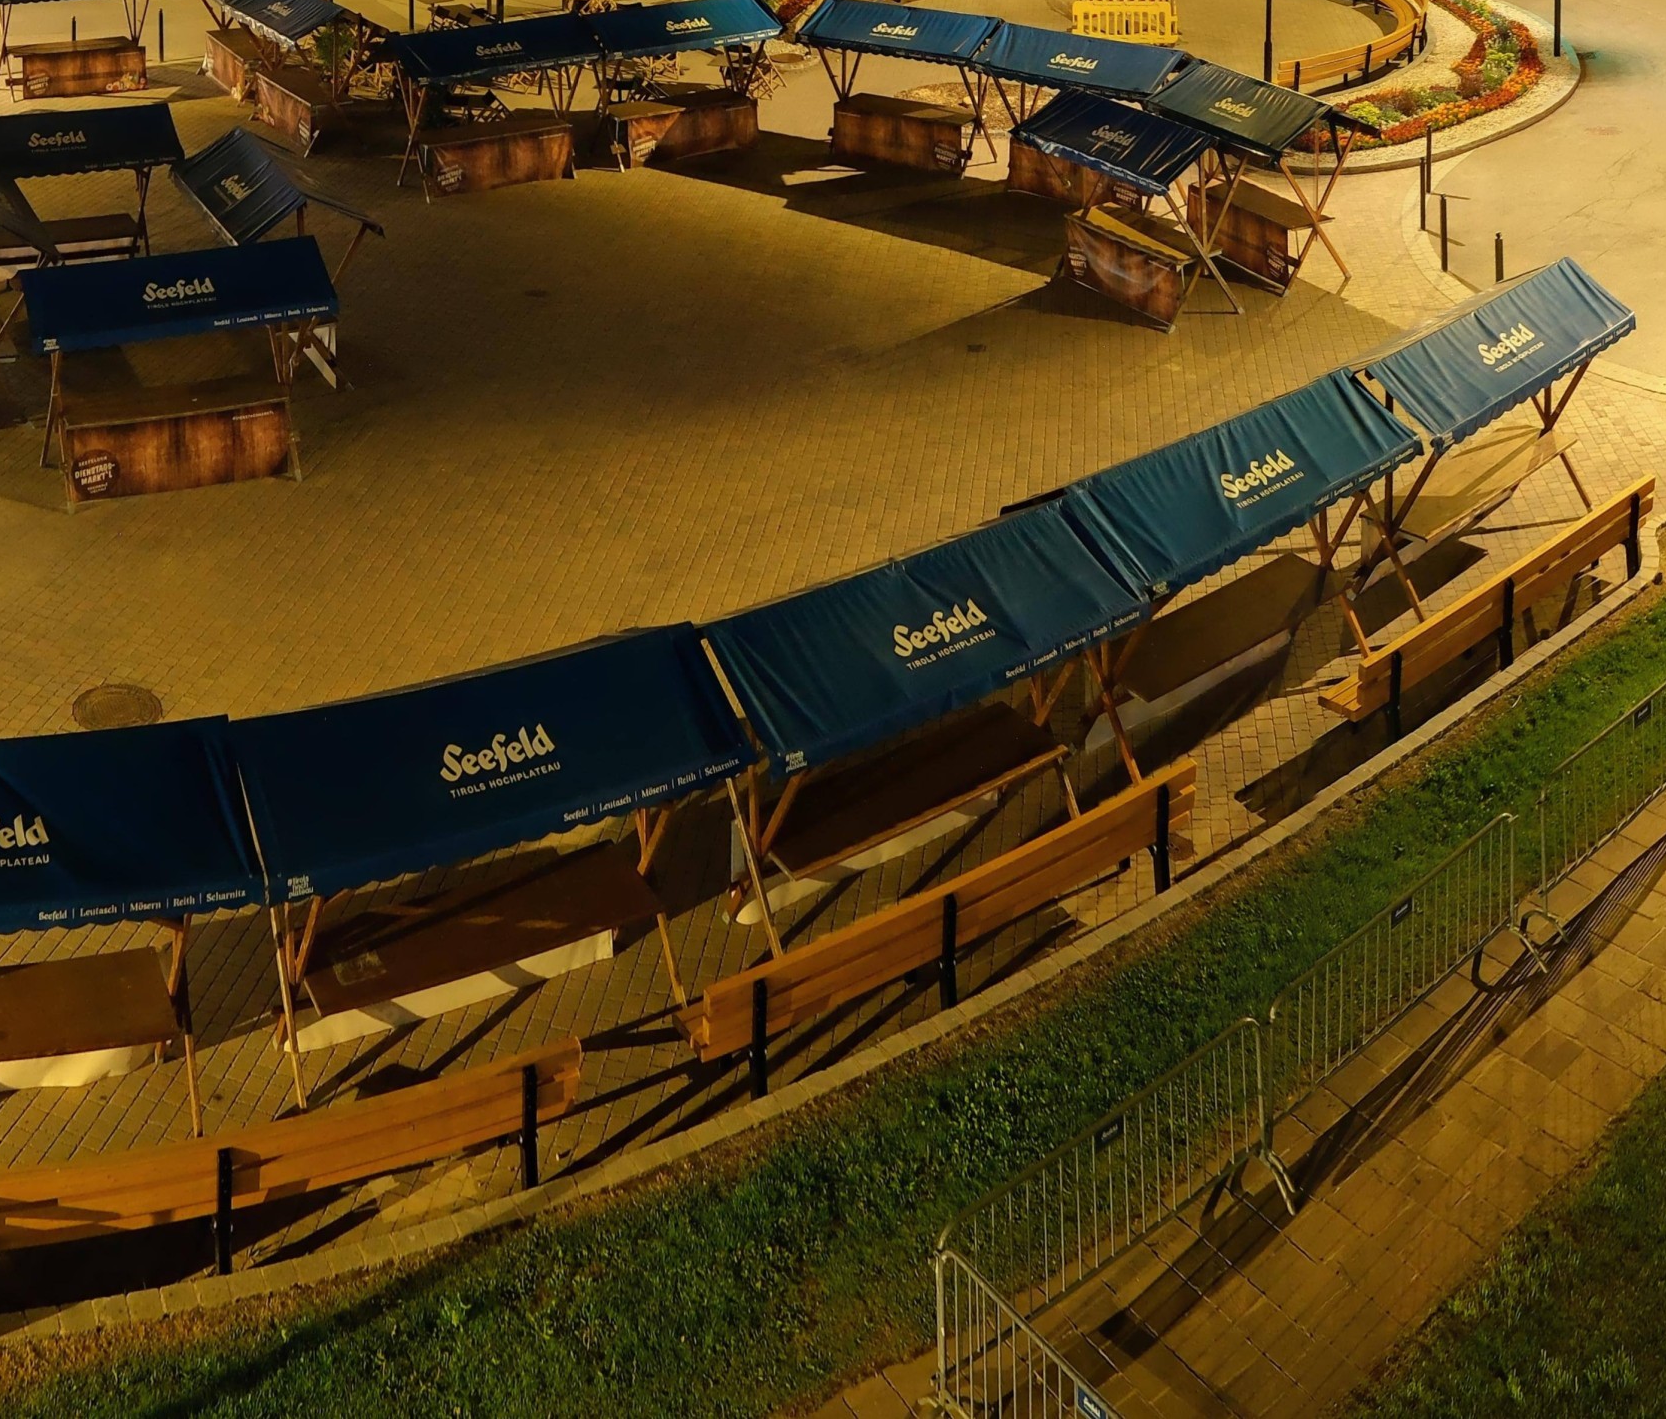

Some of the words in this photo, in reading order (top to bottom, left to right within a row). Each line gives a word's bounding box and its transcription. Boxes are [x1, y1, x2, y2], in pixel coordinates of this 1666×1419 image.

[666, 17, 711, 32] Seefeld
[872, 23, 919, 36] Seefeld
[476, 41, 522, 57] Seefeld
[1050, 53, 1098, 70] Seefeld
[1214, 97, 1259, 119] Seefeld
[28, 130, 87, 149] Seefeld
[1091, 125, 1137, 147] Seefeld
[143, 277, 215, 303] Seefeld
[1477, 322, 1536, 366] Seefeld
[1220, 448, 1295, 499] Seefeld
[1236, 493, 1260, 510] TIROLS
[1259, 470, 1305, 498] HOCHPLATEAU
[893, 598, 988, 658] Seefeld
[906, 652, 937, 671] TIROLS
[937, 628, 996, 660] HOCHPLATEAU
[1005, 665, 1026, 679] Seefeld
[1033, 649, 1058, 666] Leutasch
[439, 723, 556, 783] Seefeld
[450, 781, 487, 799] TIROLS
[488, 761, 561, 789] HOCHPLATEAU
[563, 808, 589, 823] Seefeld
[599, 794, 632, 813] Leutasch
[640, 783, 669, 799] Mösern
[677, 772, 697, 787] Reith
[704, 757, 740, 778] Scharnitz
[38, 910, 68, 922] Seefeld
[80, 904, 118, 917] Leutasch
[130, 899, 162, 911] Mösern
[173, 895, 196, 907] Reith
[206, 889, 246, 903] Scharnitz
